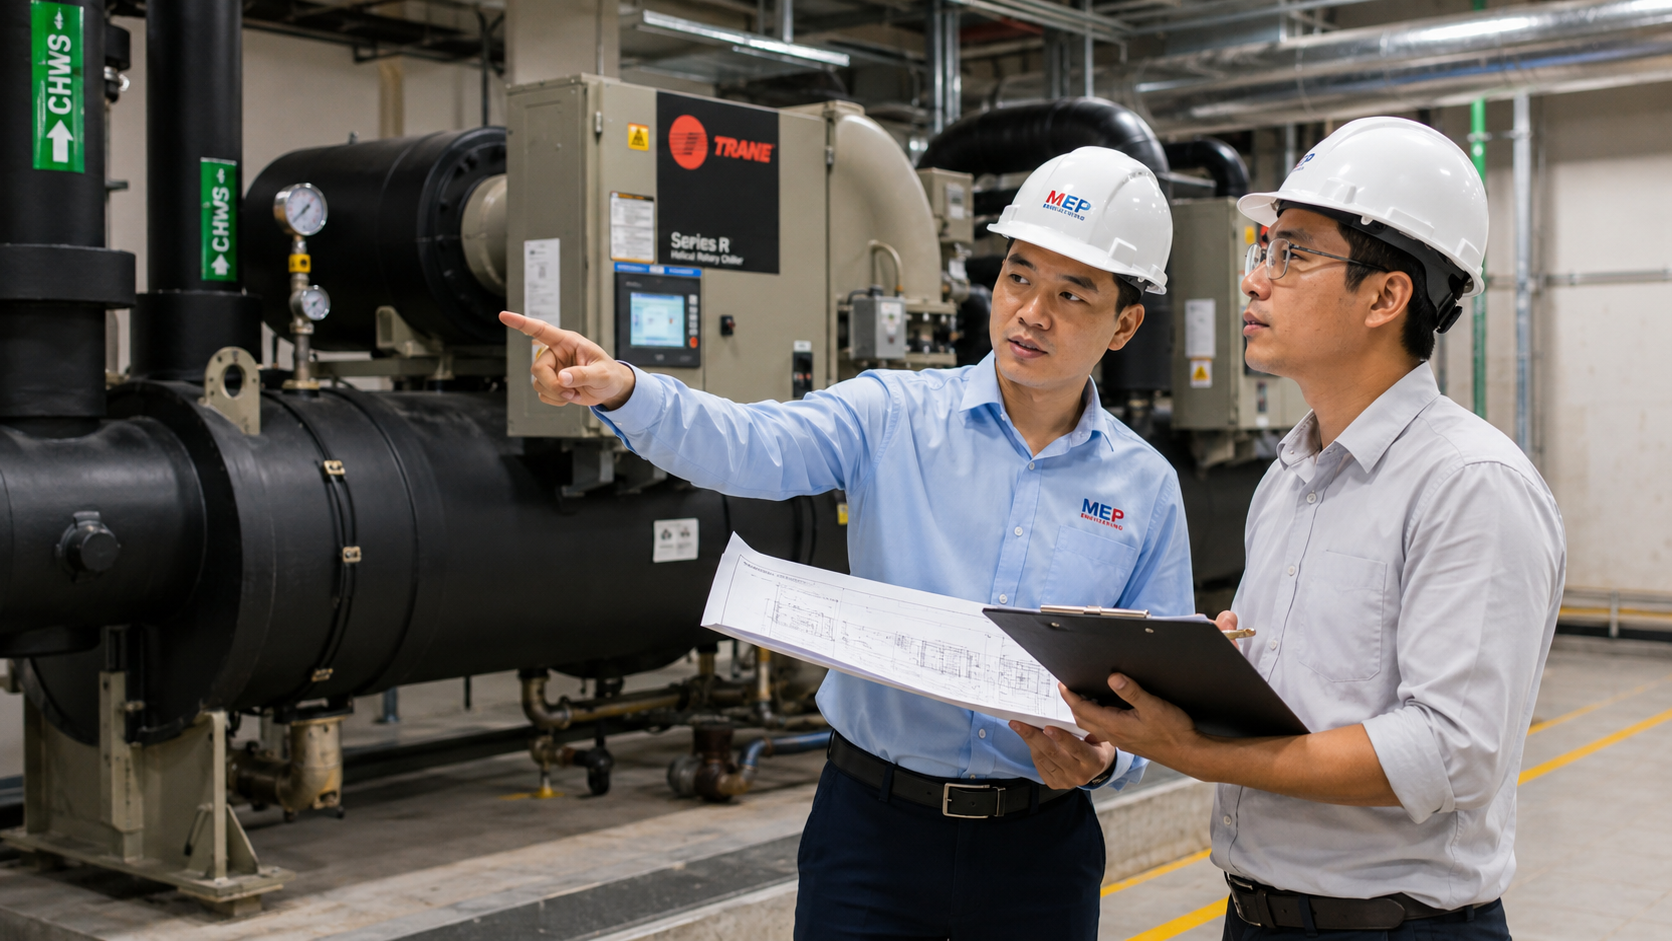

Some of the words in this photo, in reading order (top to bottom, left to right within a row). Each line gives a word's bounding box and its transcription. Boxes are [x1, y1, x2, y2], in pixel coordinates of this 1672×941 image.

[47, 33, 72, 115] CHWS
[714, 135, 774, 163] TRANE
[1045, 189, 1092, 213] MEP
[211, 186, 230, 253] CHWS
[670, 231, 717, 252] Series
[719, 236, 730, 253] R
[1082, 498, 1124, 522] MEP
